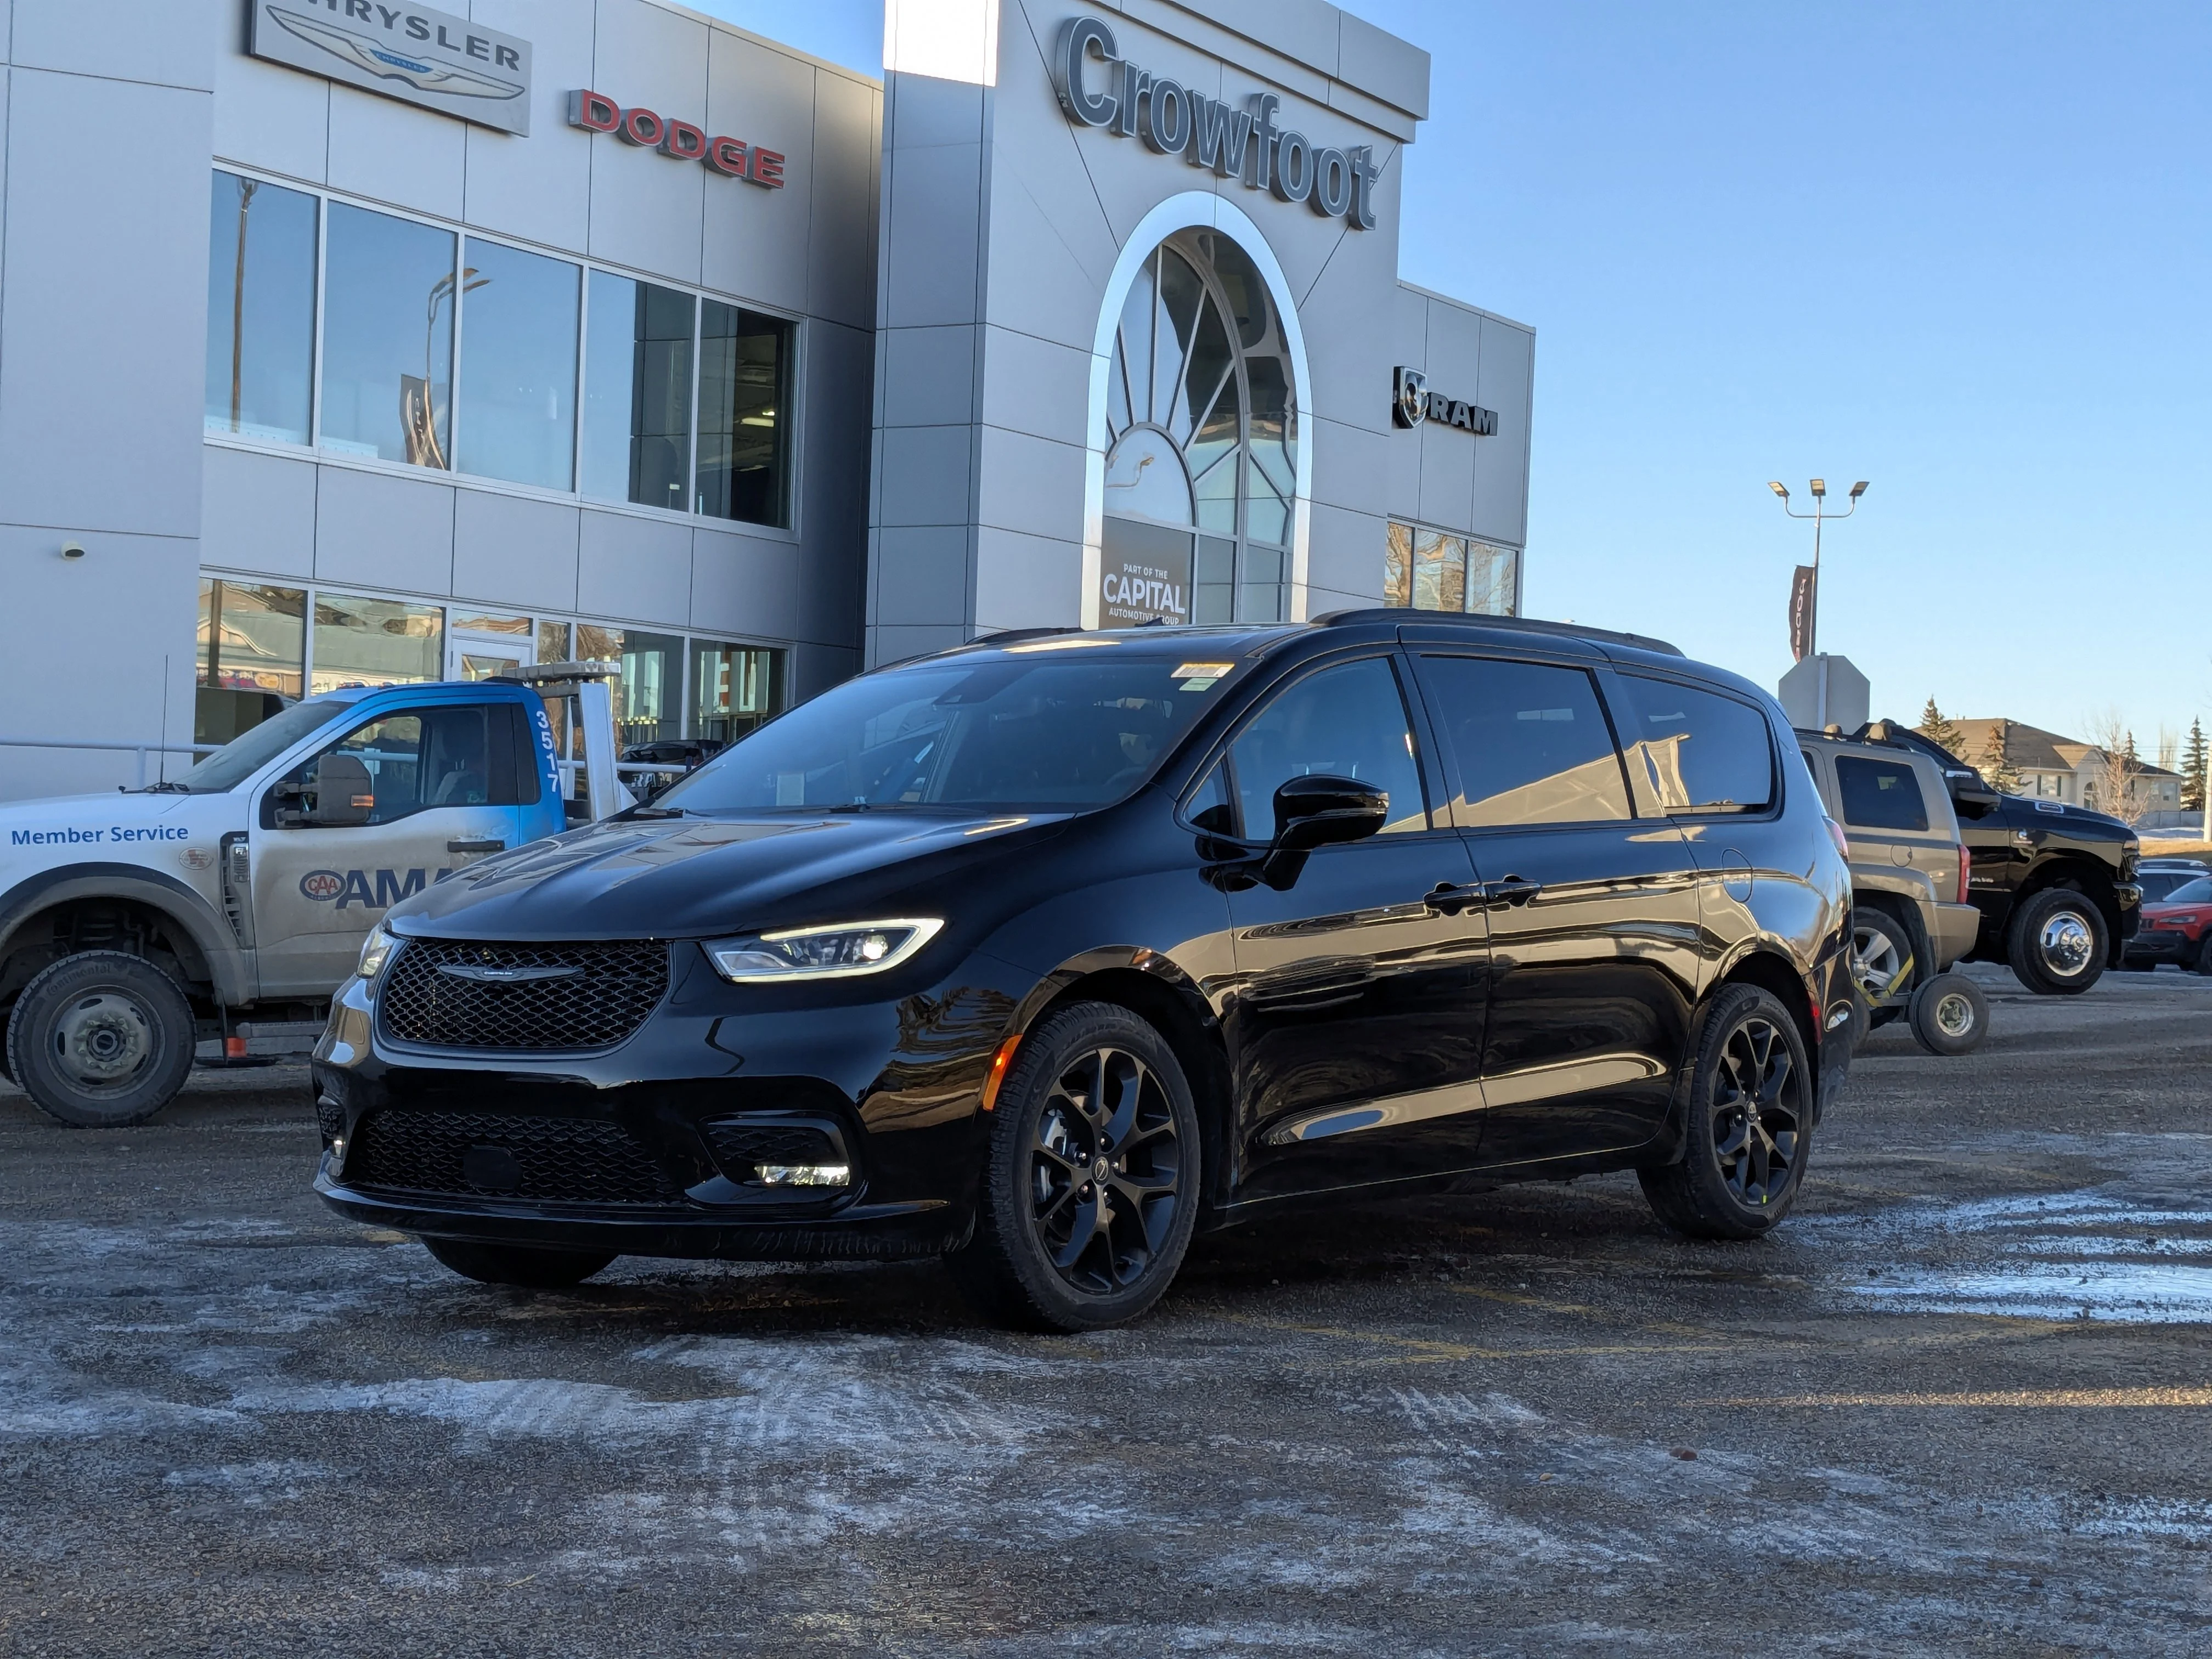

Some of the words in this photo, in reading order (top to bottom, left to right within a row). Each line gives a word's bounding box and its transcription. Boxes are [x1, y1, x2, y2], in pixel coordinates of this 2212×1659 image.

[308, 0, 520, 71] RYSLER
[571, 89, 785, 189] DODGE
[1057, 15, 1378, 231] Crowfoot
[1427, 392, 1498, 436] RAM
[1124, 563, 1142, 575] PART
[1143, 567, 1153, 577] OF
[1155, 568, 1168, 580] THE
[1103, 574, 1186, 614] CAPITAL
[1108, 607, 1153, 622] AUTOMOTIVE
[536, 710, 558, 792] 3517
[12, 827, 104, 845] Member
[111, 825, 189, 843] Service
[308, 875, 338, 895] CAA
[335, 868, 454, 909] AM
